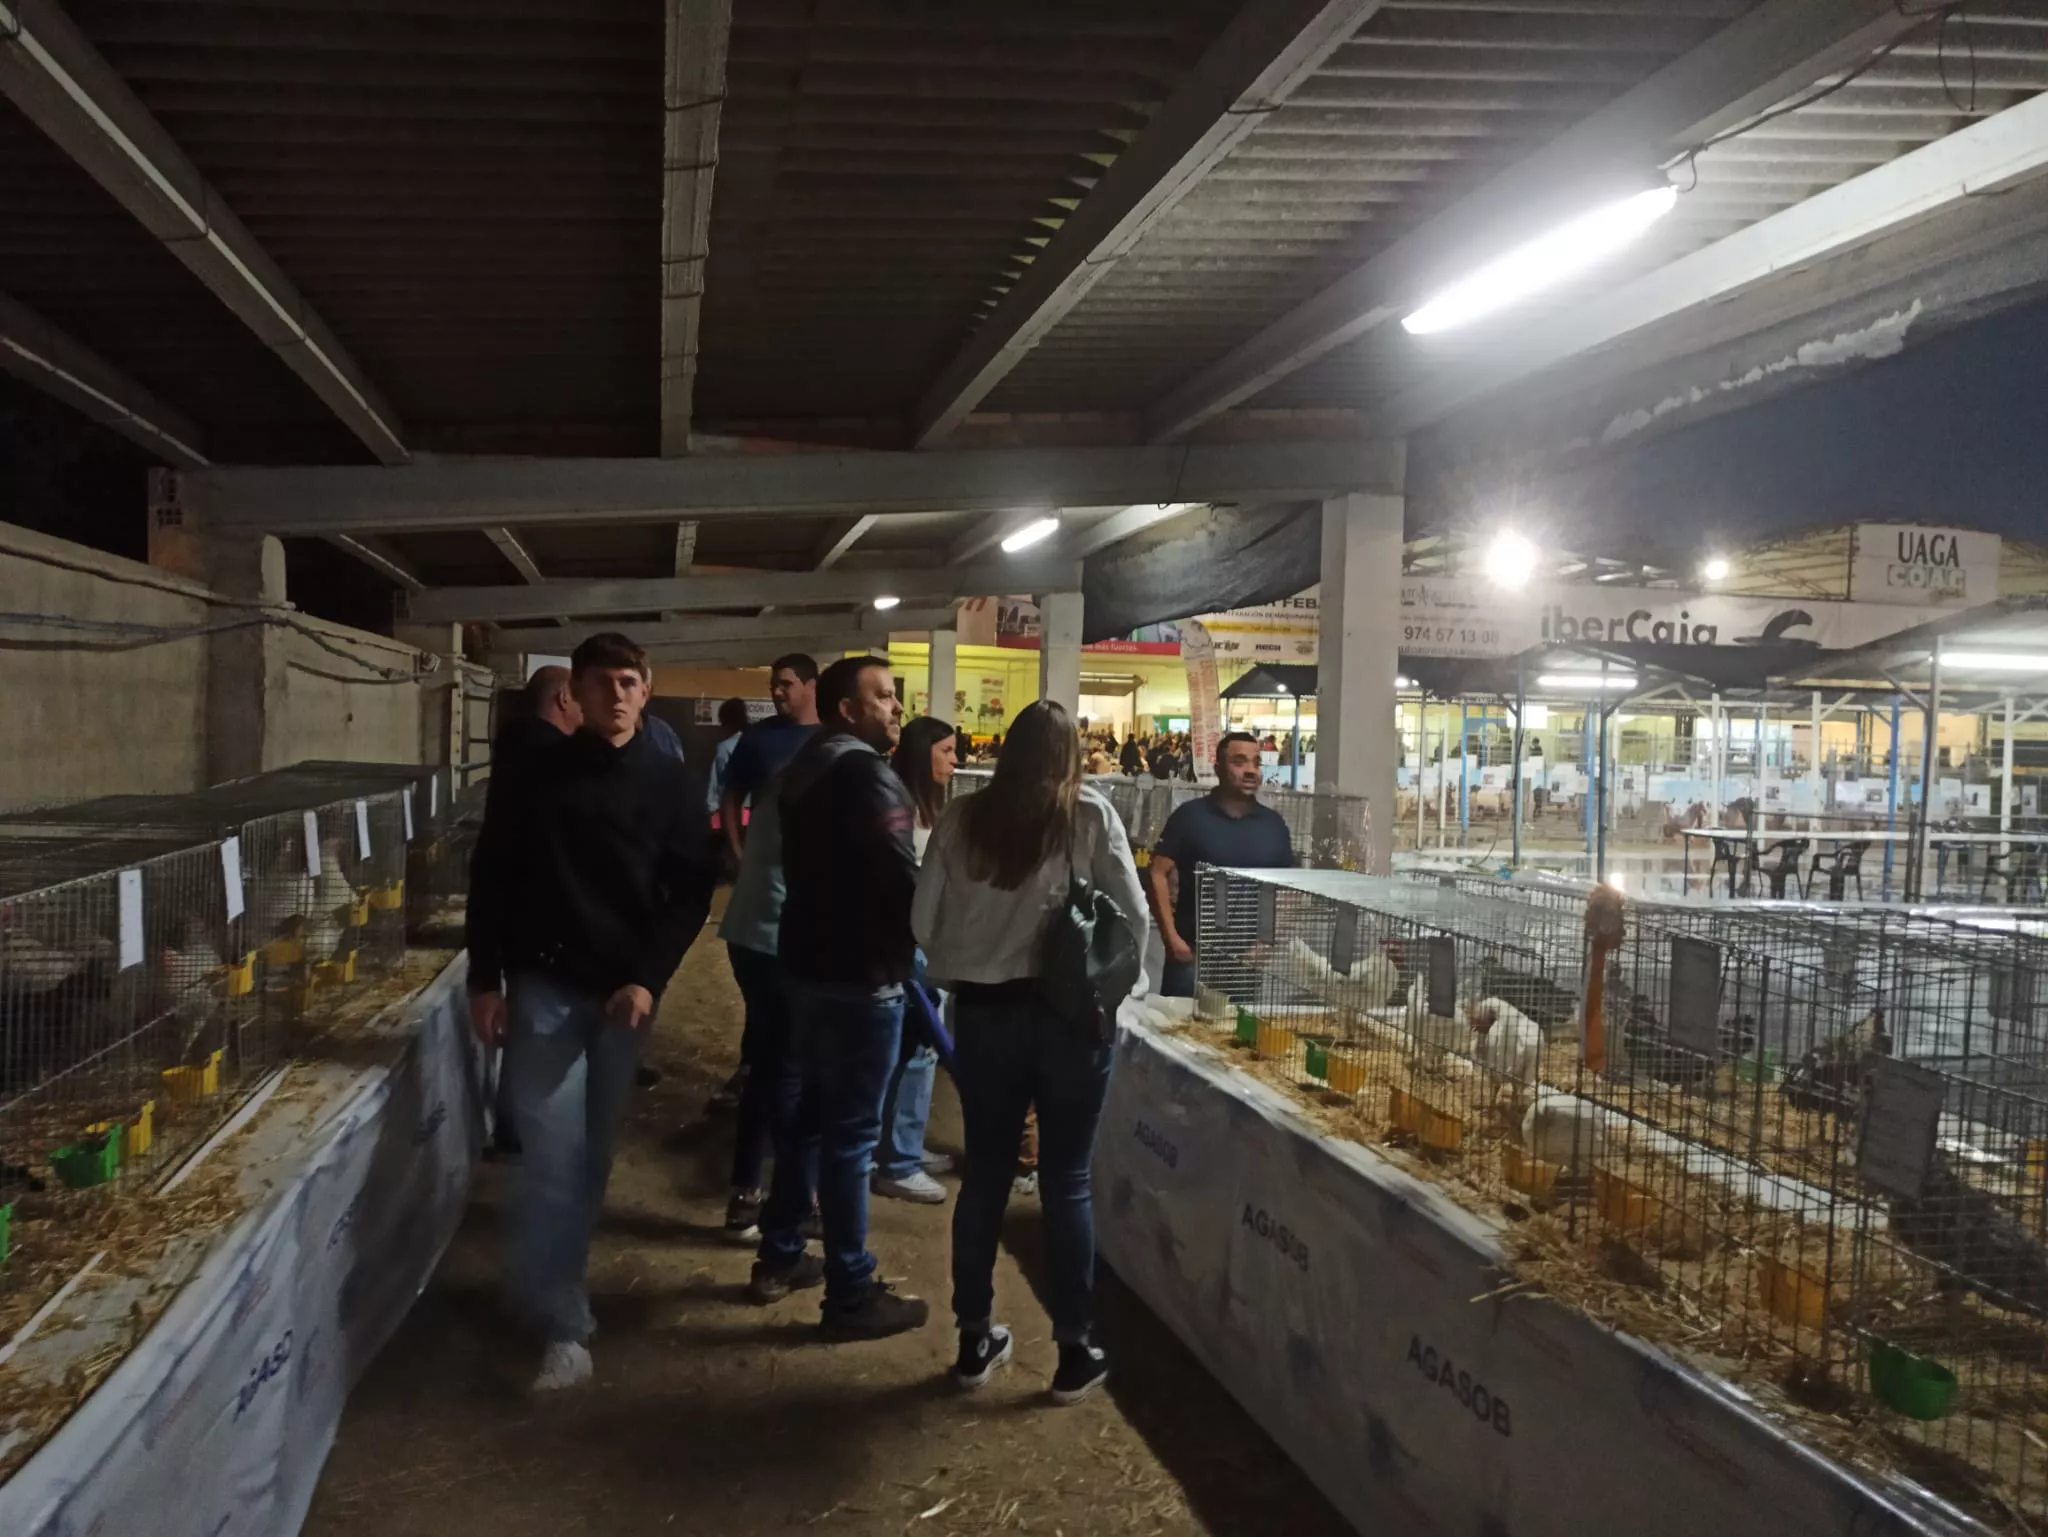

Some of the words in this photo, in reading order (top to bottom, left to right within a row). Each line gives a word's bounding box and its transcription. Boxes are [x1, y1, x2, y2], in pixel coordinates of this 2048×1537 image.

[1898, 531, 1960, 568] UAGA
[1283, 598, 1320, 609] FEB
[1404, 625, 1431, 641] 974
[1460, 629, 1476, 644] 13
[1406, 1334, 1513, 1439] AGASOB
